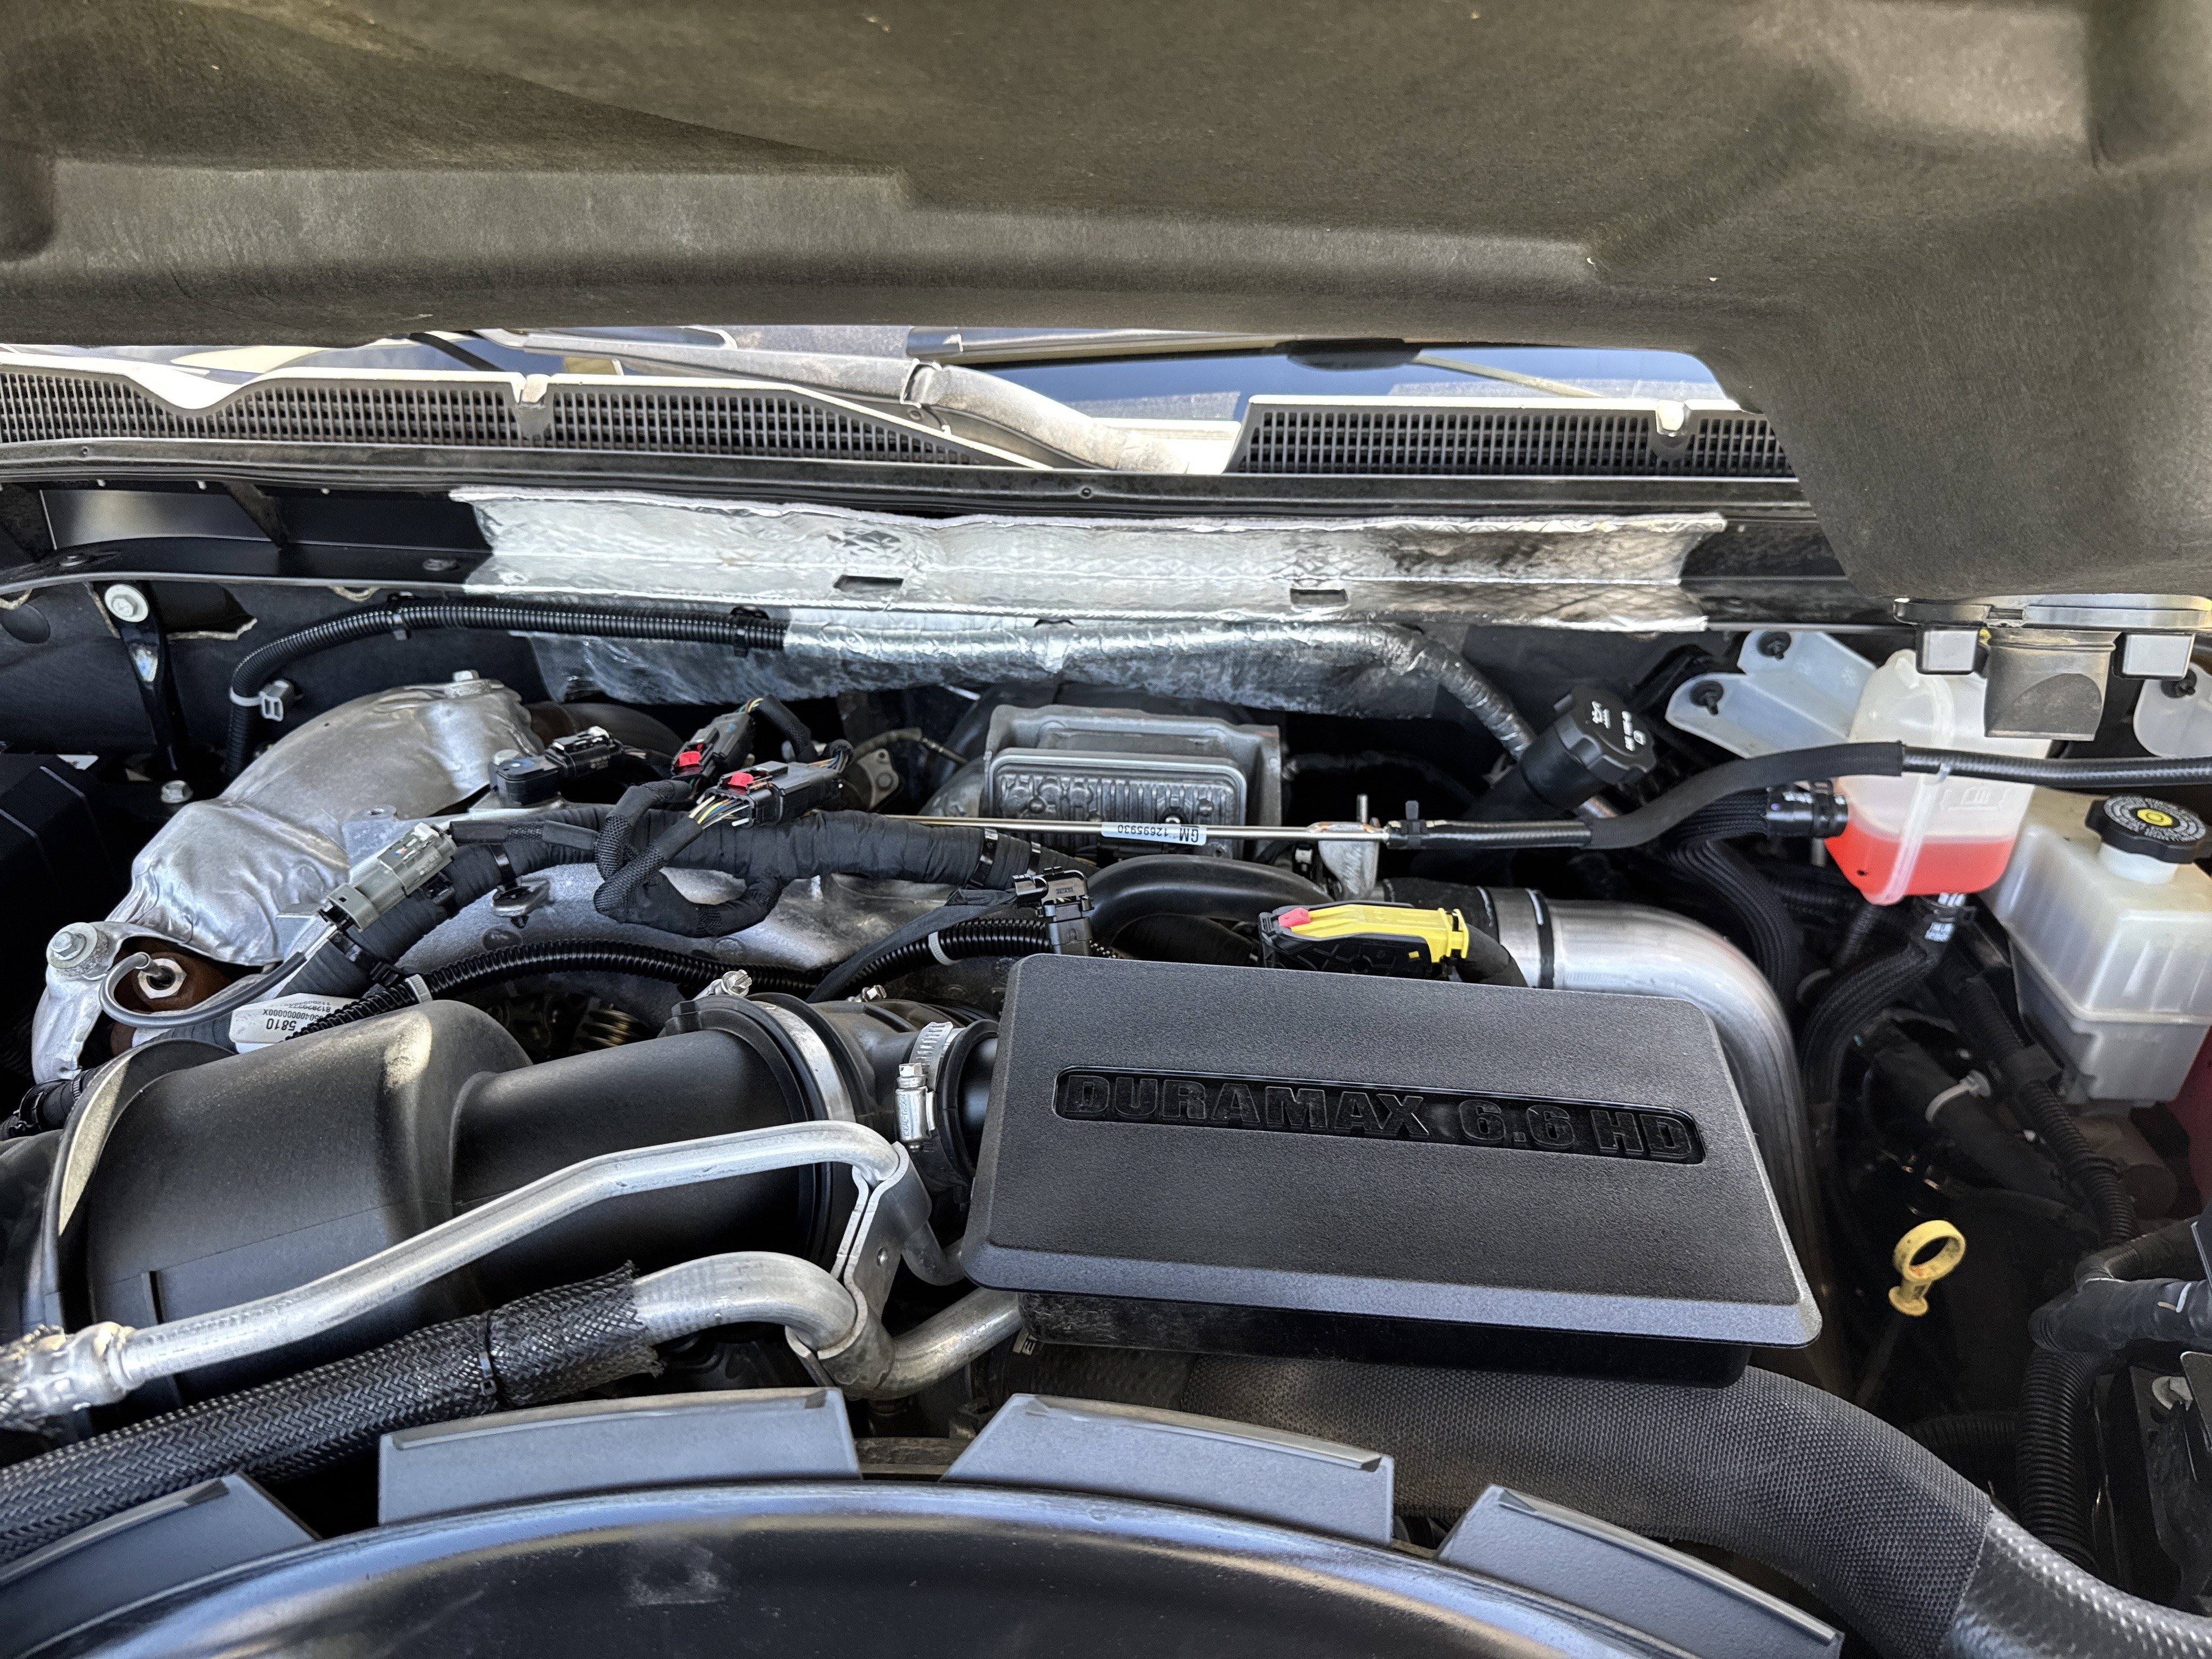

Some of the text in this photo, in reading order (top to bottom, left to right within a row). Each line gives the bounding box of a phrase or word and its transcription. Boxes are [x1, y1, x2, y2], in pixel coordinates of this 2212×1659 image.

[1118, 825, 1199, 843] GM 12695930
[266, 1018, 297, 1031] 5810
[1063, 1075, 1694, 1160] DURAMAX 6.6 HD
